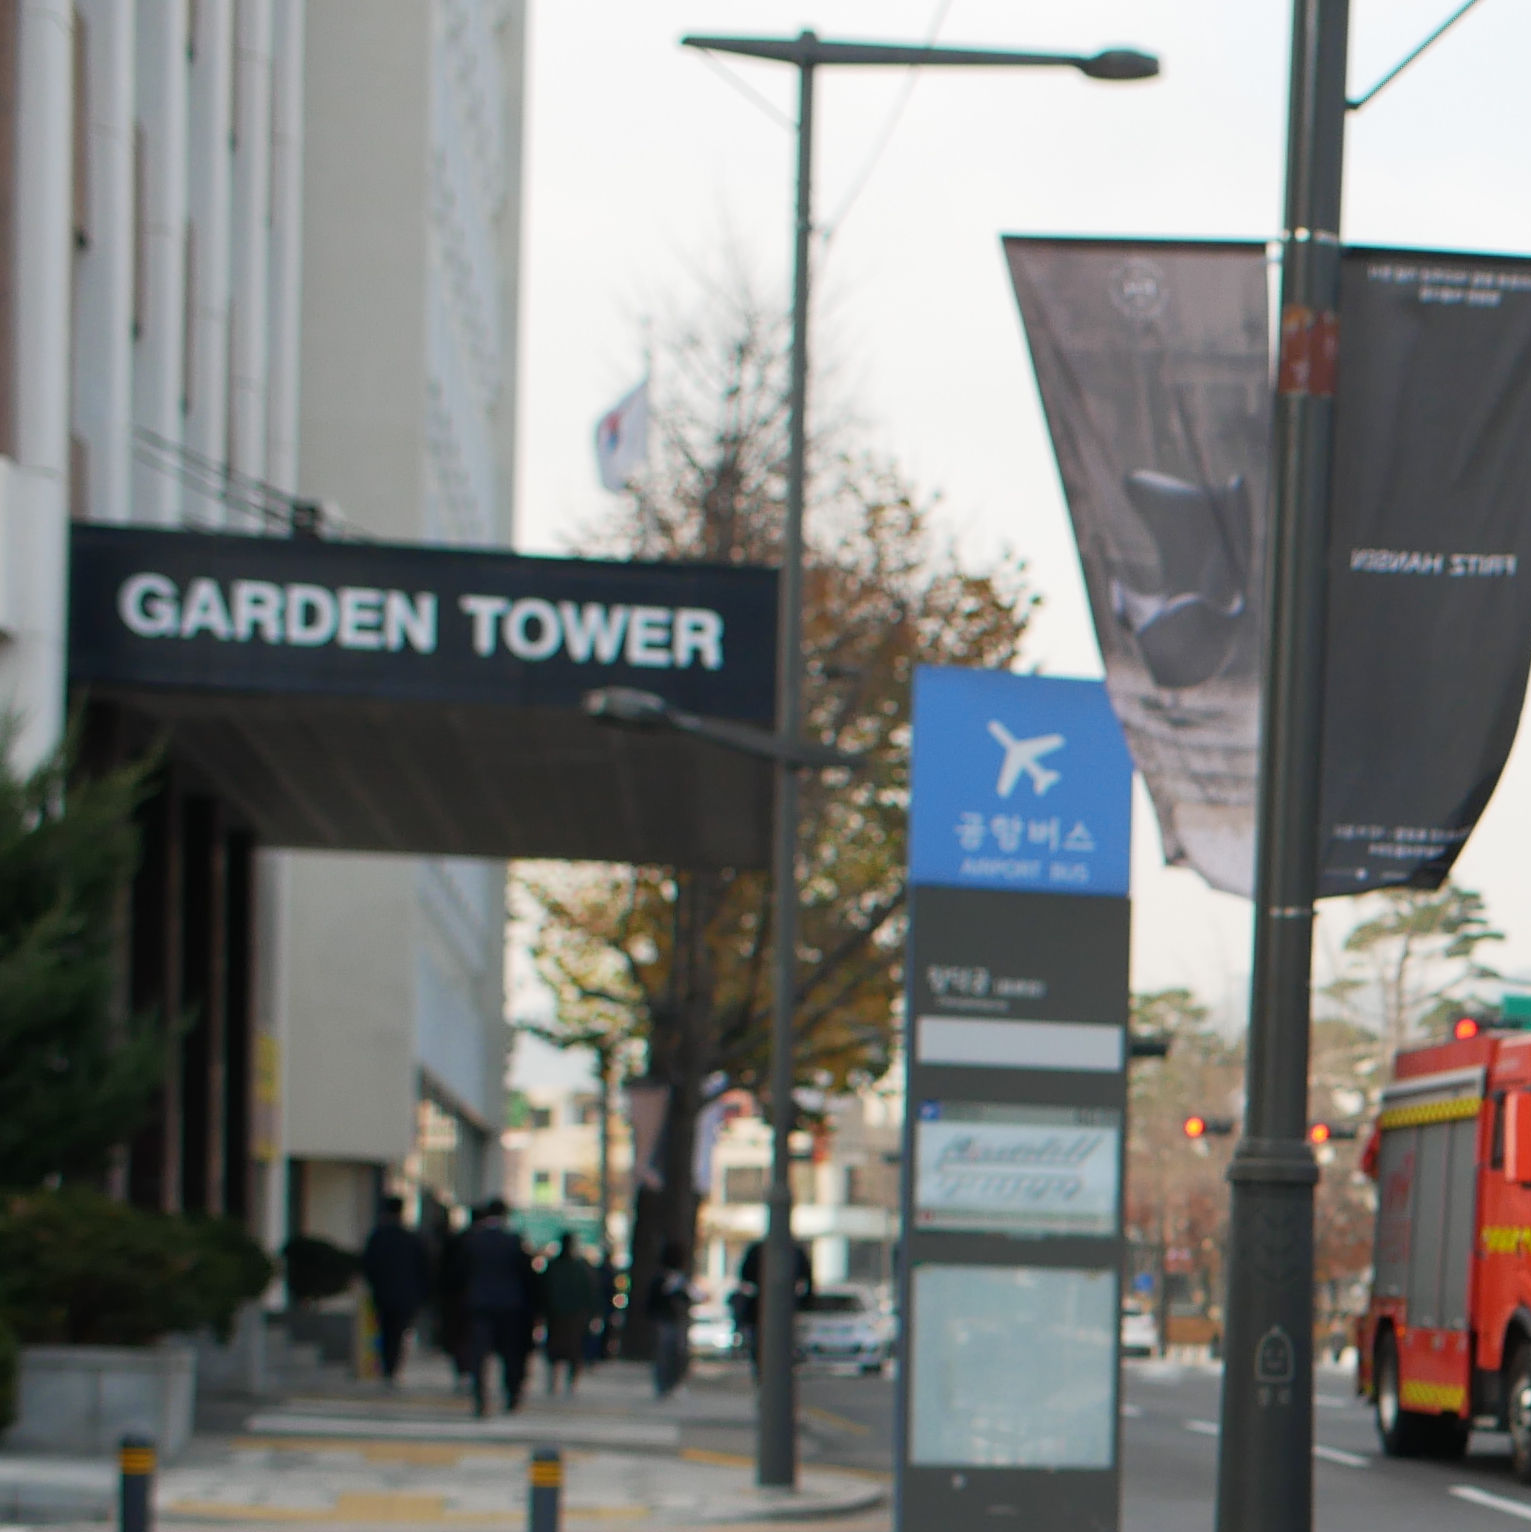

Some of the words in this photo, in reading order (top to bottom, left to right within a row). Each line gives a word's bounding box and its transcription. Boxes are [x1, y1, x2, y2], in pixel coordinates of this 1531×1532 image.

[118, 573, 438, 655] GARDEN
[460, 594, 725, 671] TOWER
[955, 811, 1096, 853] 공항버스
[960, 858, 1042, 879] AIRPORT
[1049, 861, 1090, 883] BUS
